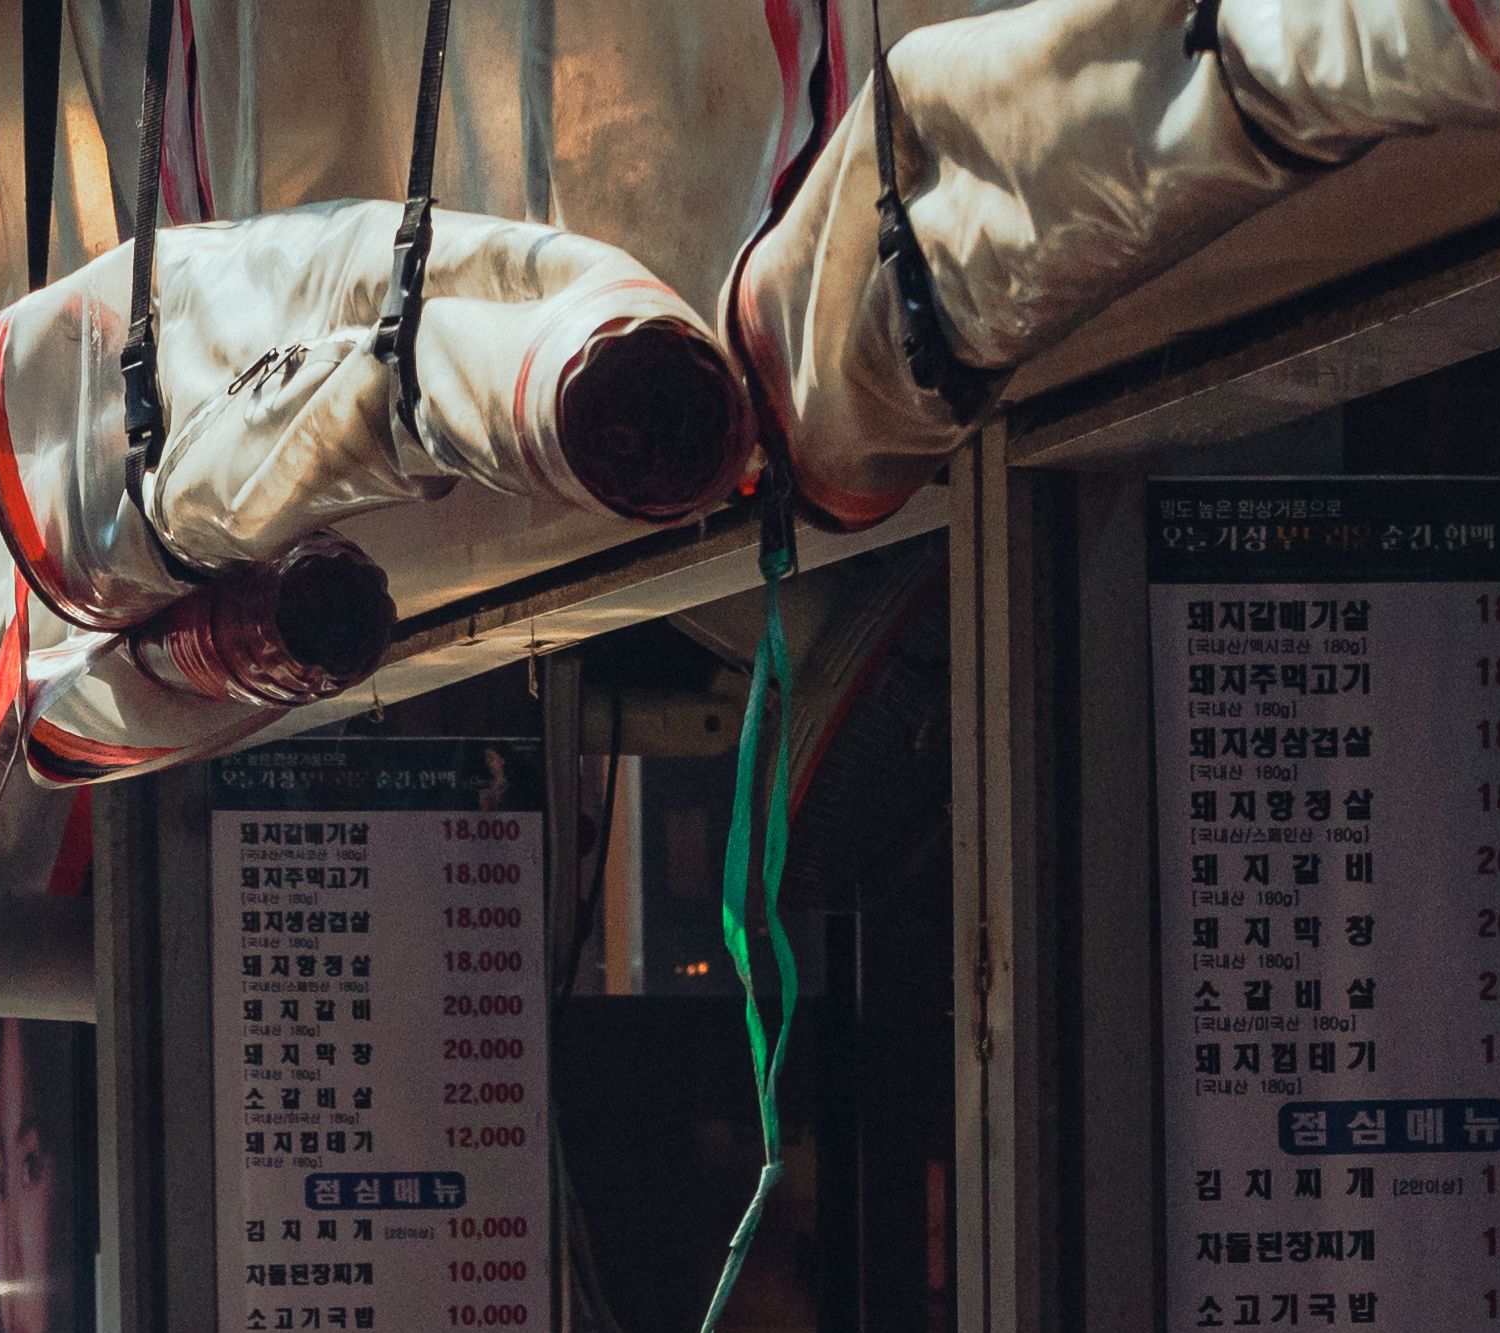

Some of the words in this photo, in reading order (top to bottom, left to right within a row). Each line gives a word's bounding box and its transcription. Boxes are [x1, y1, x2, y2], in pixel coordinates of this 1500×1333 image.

[1188, 600, 1370, 632] 돼지갈매기살
[1189, 663, 1370, 695] 돼지주먹고기
[1190, 726, 1372, 759] 돼지생삼겹살
[443, 819, 520, 842] 18,000
[444, 863, 520, 885] 18,000
[444, 907, 521, 928] 18,000
[445, 951, 522, 972] 18,000
[444, 995, 523, 1017] 20,000
[444, 1039, 523, 1059] 20,000
[444, 1082, 524, 1104] 22,000
[446, 1126, 525, 1148] 12,000
[1290, 1107, 1500, 1149] 점심메뉴
[1195, 1168, 1374, 1201] 김치찌개
[448, 1217, 527, 1238] 10,000
[1196, 1230, 1374, 1264] 차돌된장찌개
[449, 1261, 527, 1282] 10,000
[448, 1304, 527, 1326] 10,000
[1197, 1292, 1378, 1327] 소고기국밥
